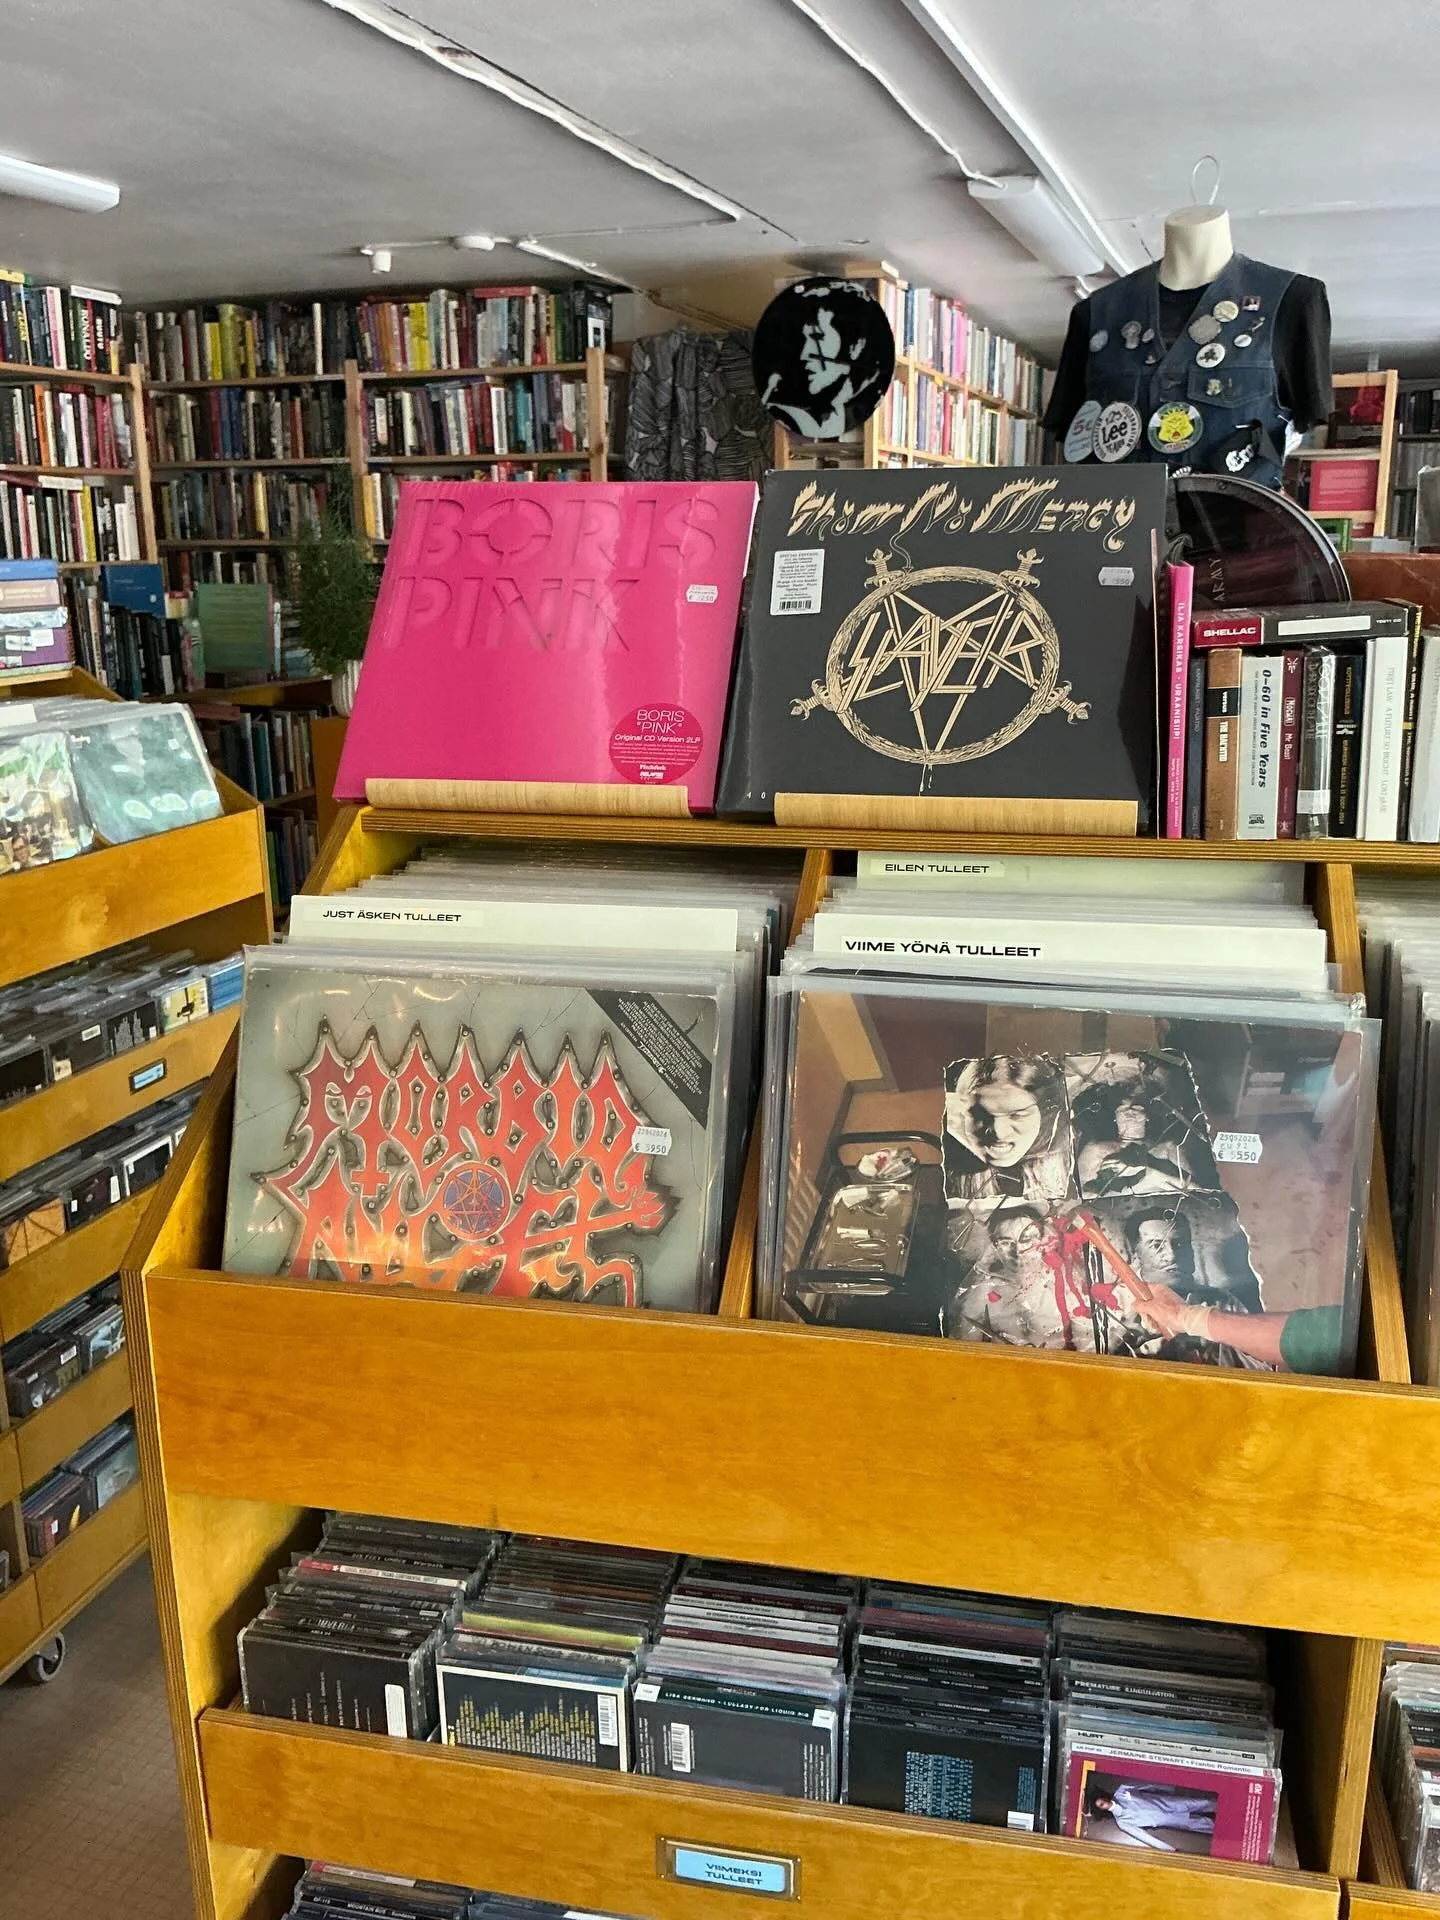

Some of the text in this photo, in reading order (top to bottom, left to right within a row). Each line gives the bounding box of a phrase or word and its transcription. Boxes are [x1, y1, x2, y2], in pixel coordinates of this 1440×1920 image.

[1102, 421, 1128, 444] Lee
[402, 496, 722, 570] BORIS
[382, 576, 640, 652] PINK
[1203, 627, 1257, 637] SHELLAC
[837, 611, 1048, 712] SLAYER
[1173, 602, 1185, 739] ILJA KARSIKAS URAANISIIPI
[637, 709, 685, 722] BORIS
[1261, 706, 1271, 719] in
[1220, 721, 1229, 732] THE
[1259, 722, 1271, 749] Five
[614, 734, 642, 742] Original
[657, 735, 685, 743] Version
[686, 736, 701, 744] 2LP
[1284, 733, 1293, 743] Mr
[1257, 753, 1270, 788] Years
[884, 863, 989, 874] EILEN TULLEET
[322, 909, 462, 922] JUST ÄSKEN TULLEET
[845, 940, 1041, 958] VIIME YÖNÄ TULLEET
[723, 1701, 754, 1710] LULLABY
[1109, 1750, 1148, 1760] JERMAINE
[1149, 1754, 1185, 1765] STEWART
[1217, 1763, 1251, 1774] Romantic
[705, 1863, 763, 1885] VIIMEKSI TULLEET
